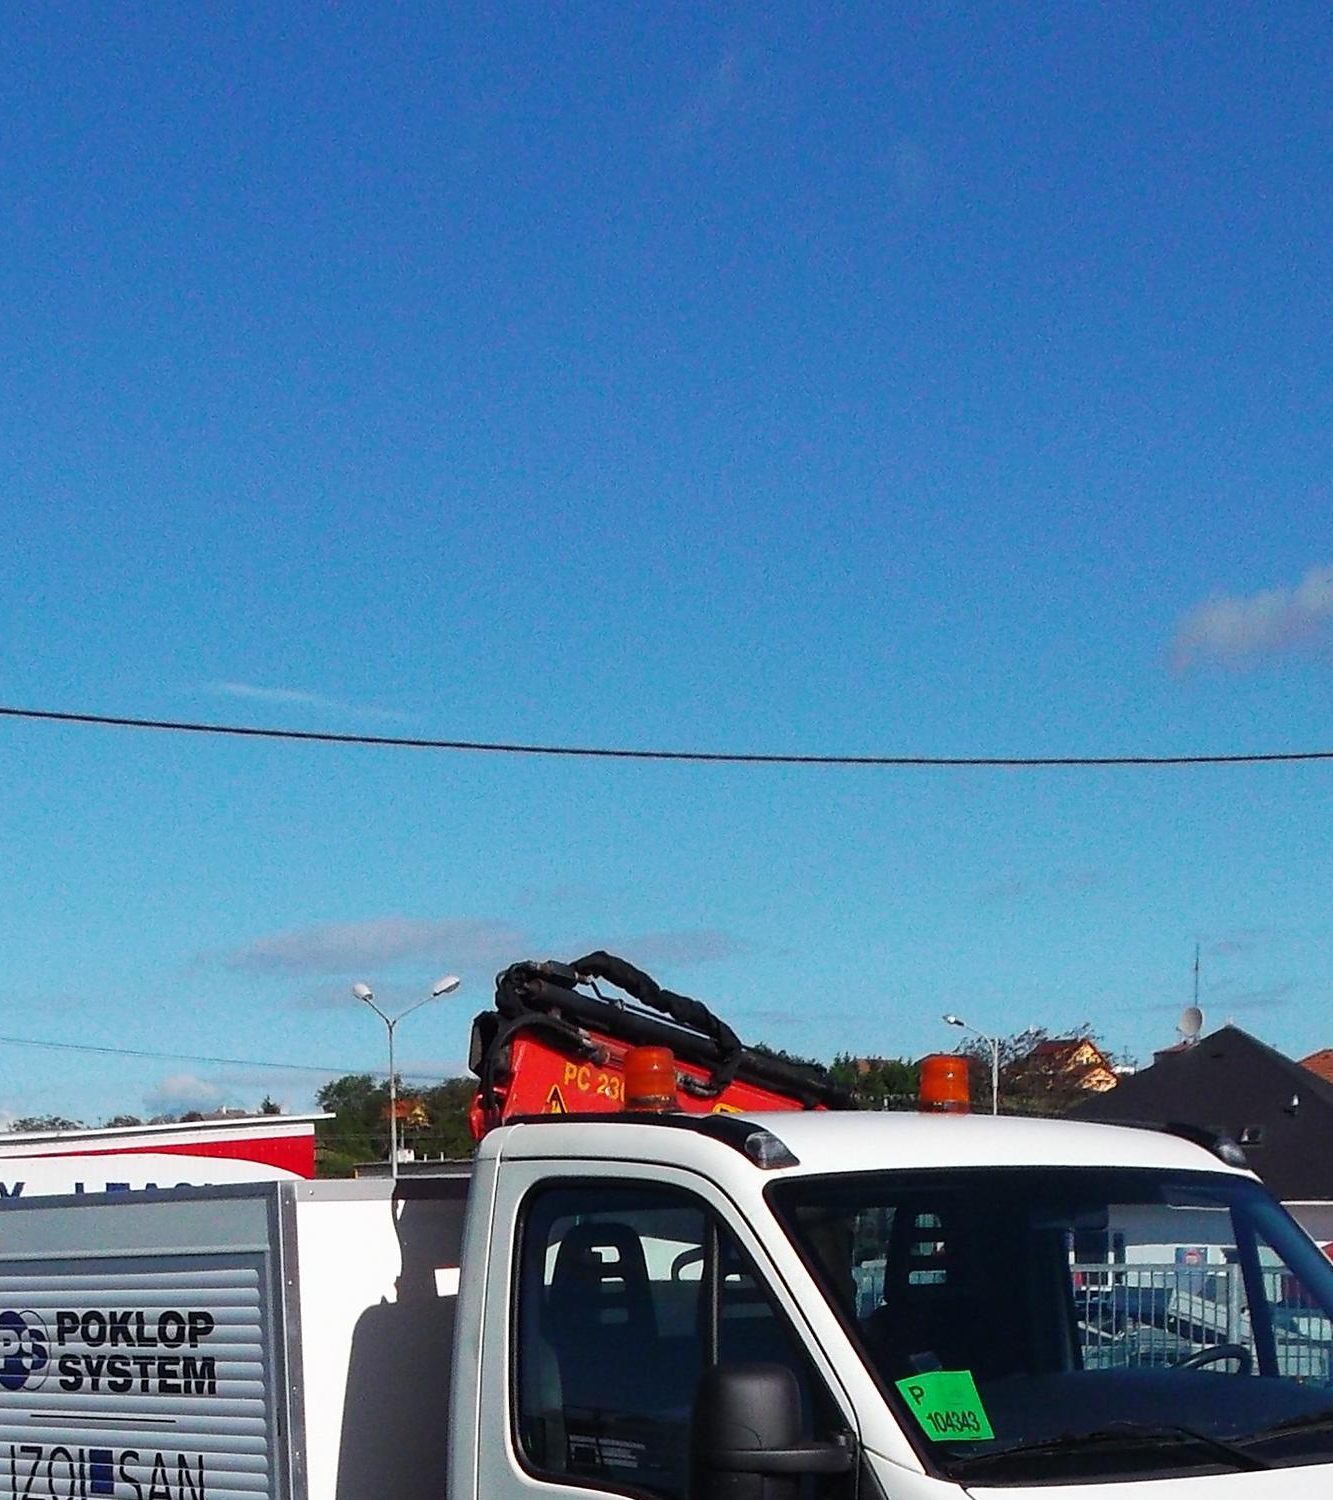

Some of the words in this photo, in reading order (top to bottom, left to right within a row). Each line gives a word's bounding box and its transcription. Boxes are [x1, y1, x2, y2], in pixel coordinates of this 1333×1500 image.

[564, 1062, 590, 1091] PC
[56, 1310, 215, 1348] POKLOP
[58, 1354, 216, 1394] SYSTEM
[908, 1386, 924, 1405] P
